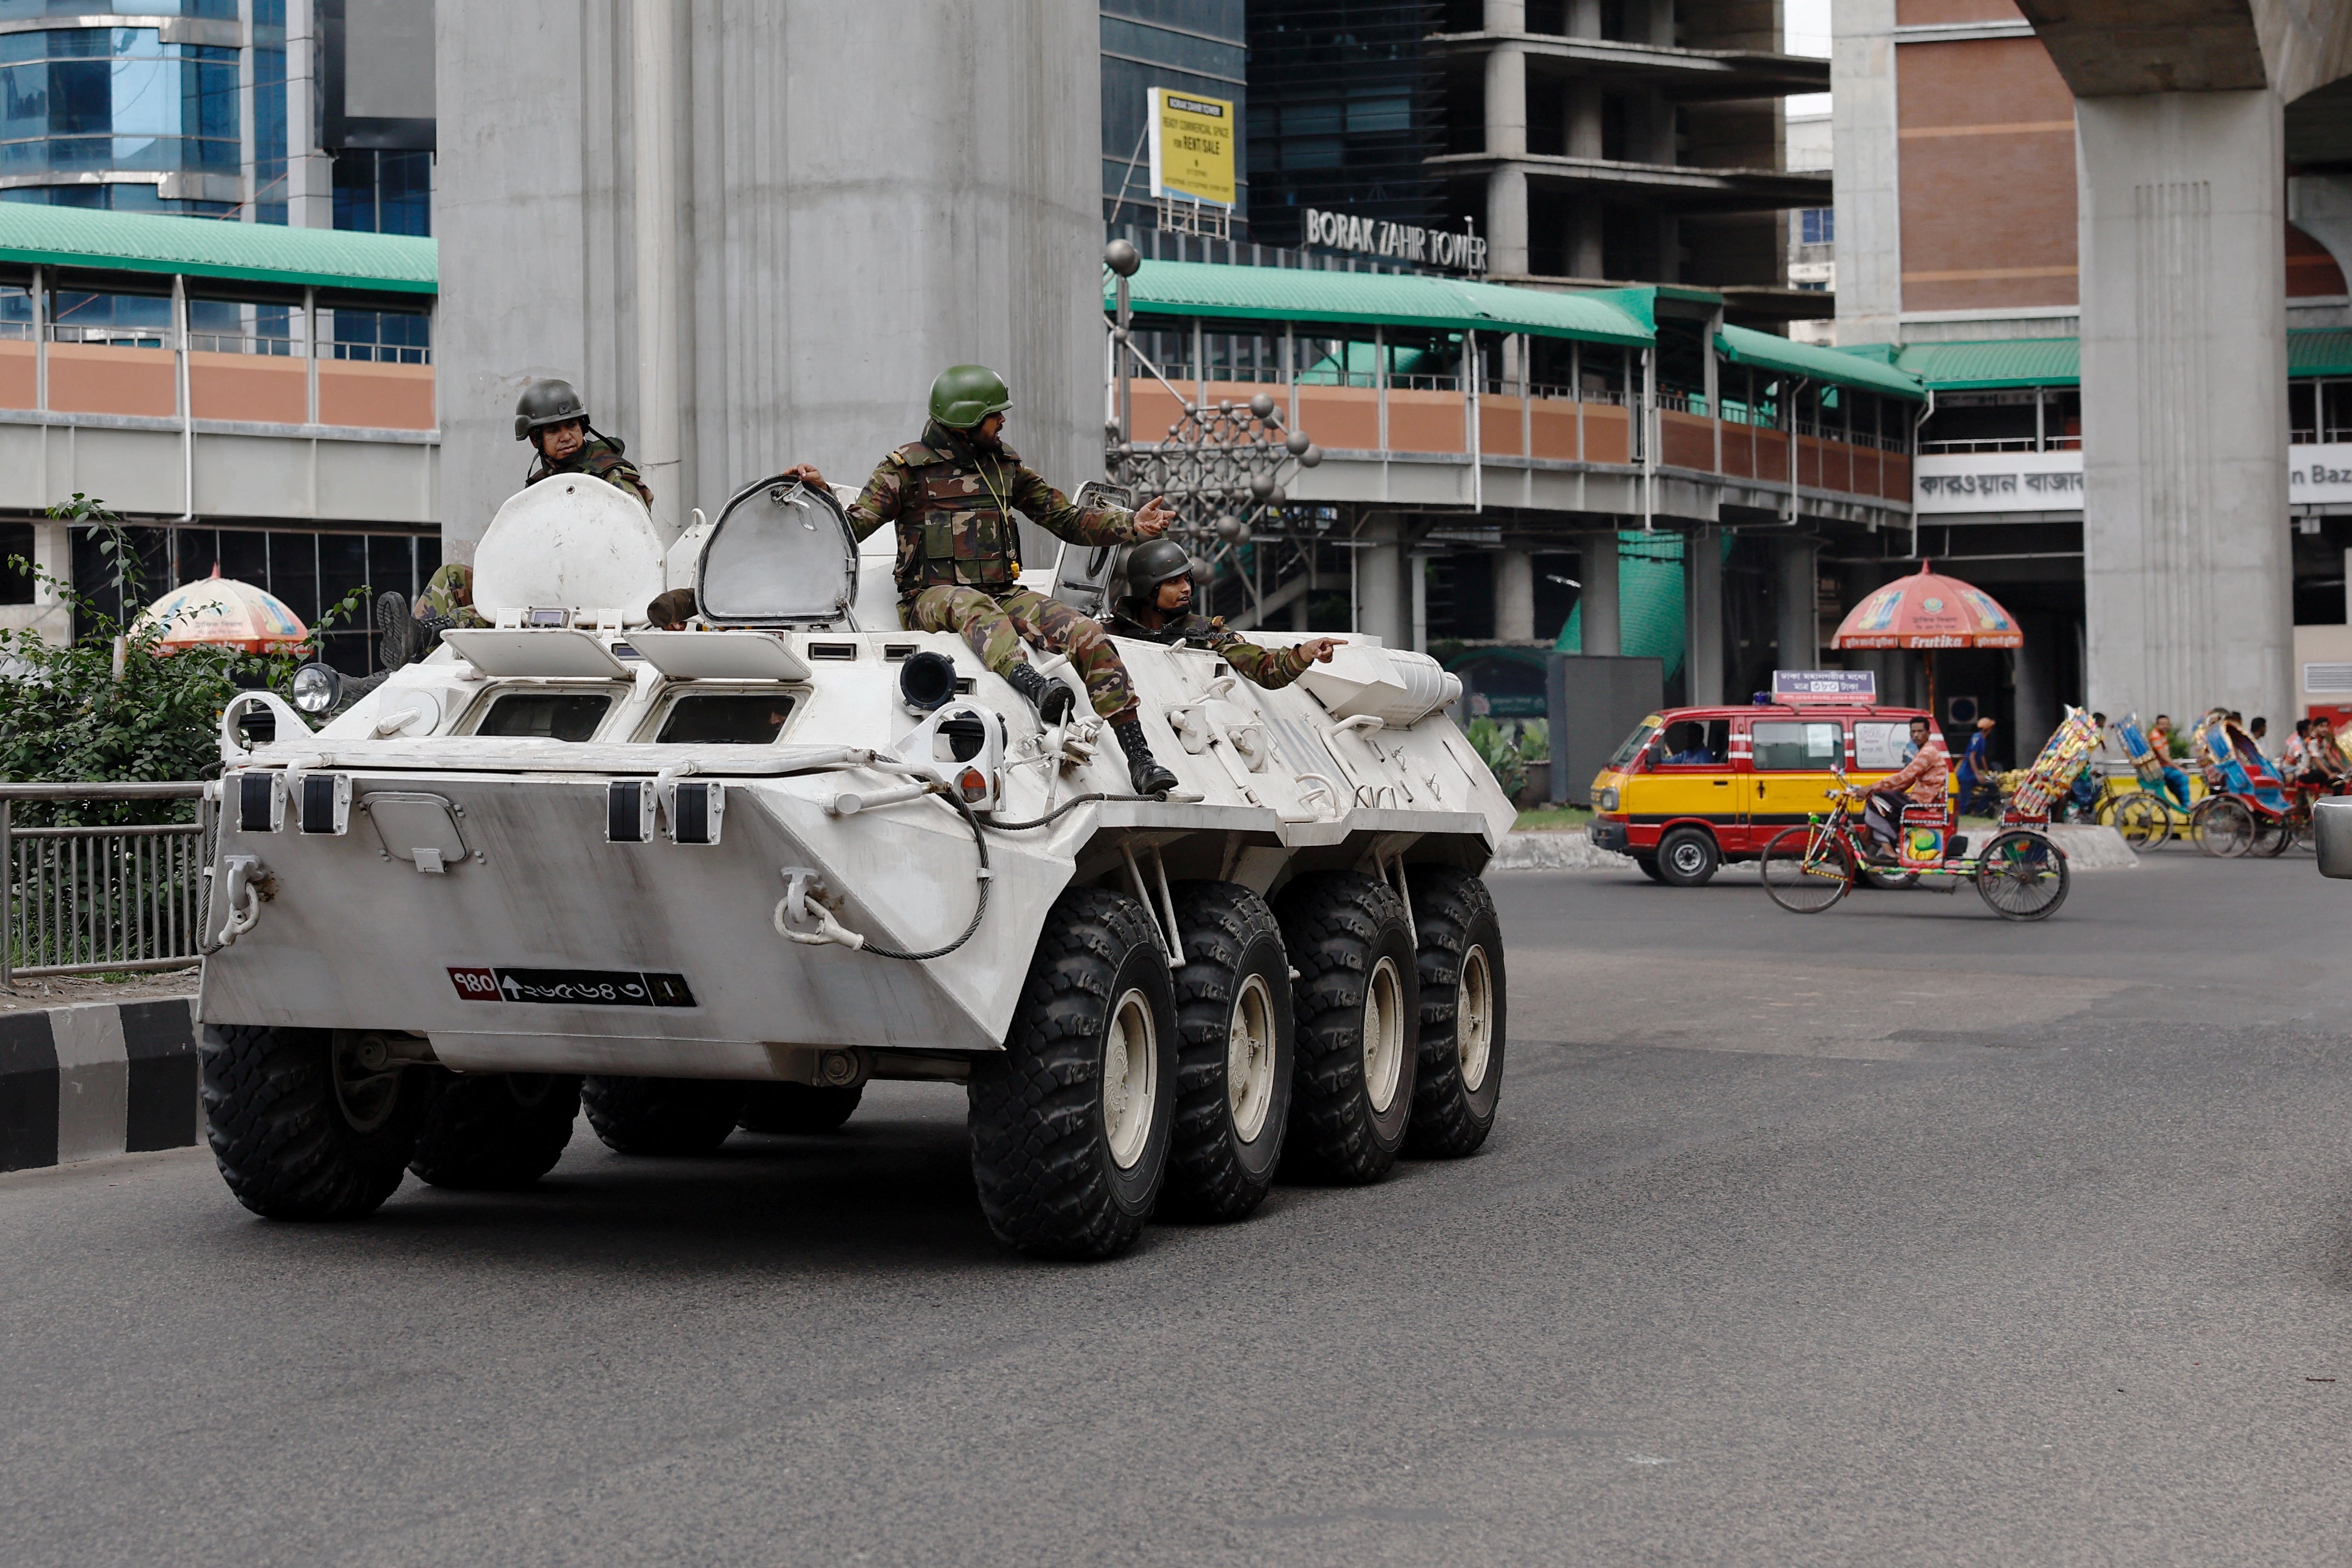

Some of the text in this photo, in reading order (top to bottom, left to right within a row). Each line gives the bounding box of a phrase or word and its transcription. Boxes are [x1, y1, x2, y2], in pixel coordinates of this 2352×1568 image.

[1306, 208, 1487, 271] BORAK ZAHIR TOWER
[1919, 473, 2017, 495] কারওয়ান
[1910, 636, 1963, 648] Frutika
